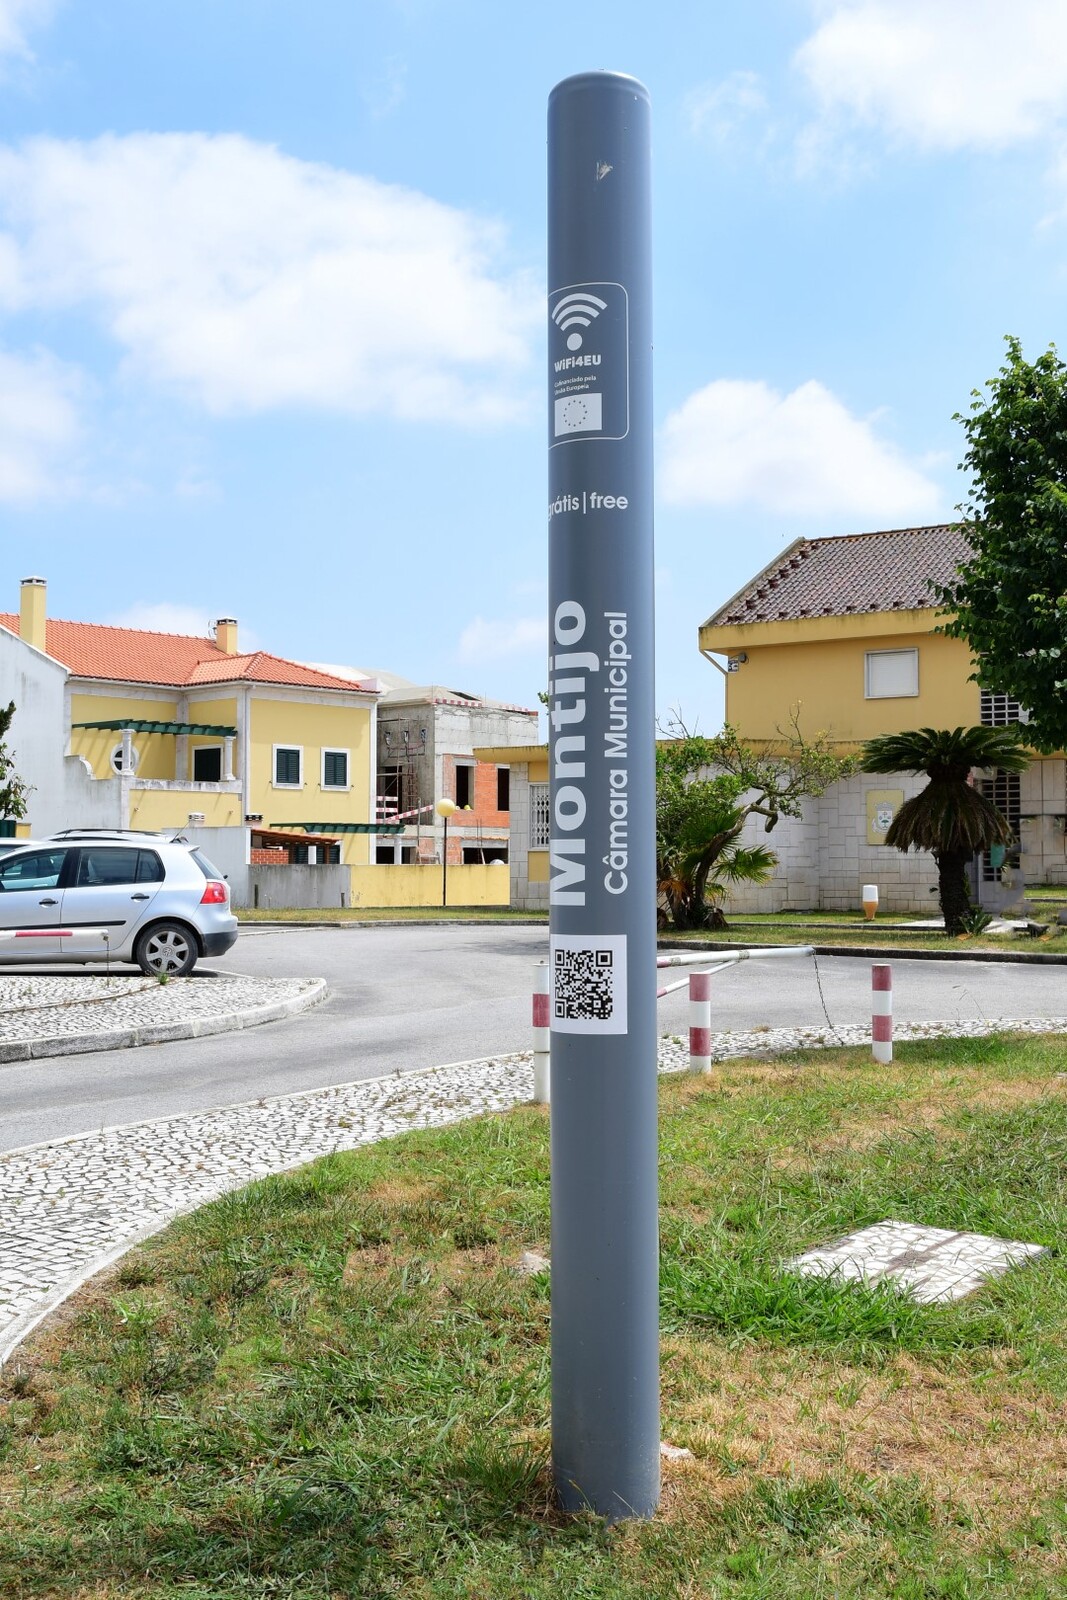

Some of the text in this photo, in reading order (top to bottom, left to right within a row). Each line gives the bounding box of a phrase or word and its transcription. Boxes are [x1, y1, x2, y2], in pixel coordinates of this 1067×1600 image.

[554, 354, 602, 373] WiFi4EU
[590, 492, 629, 509] free
[550, 600, 600, 906] Montijo
[602, 612, 631, 895] Câmara Municipal
